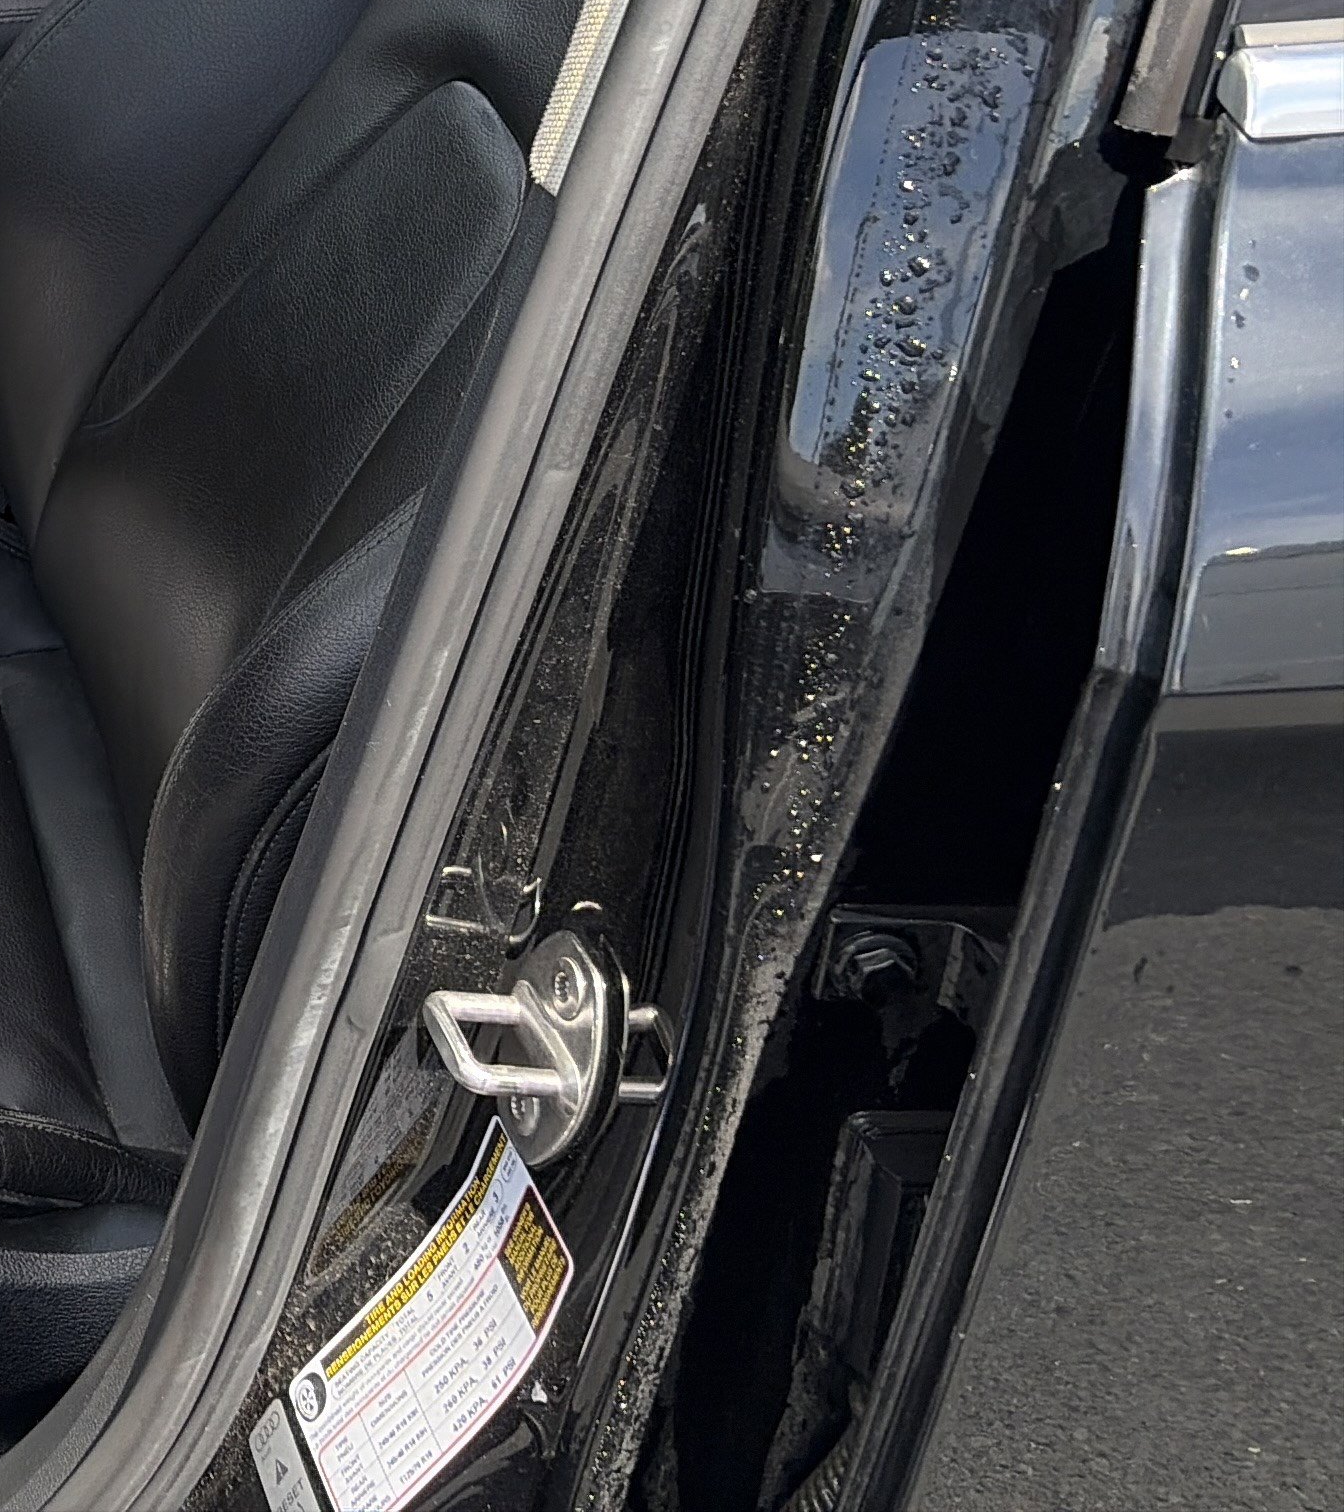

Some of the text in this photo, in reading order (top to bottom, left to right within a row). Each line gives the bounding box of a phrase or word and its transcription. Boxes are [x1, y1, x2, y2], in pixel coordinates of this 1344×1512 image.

[366, 1177, 480, 1324] TIRE AND LOADING INFORMATION
[401, 1278, 420, 1303] SUR
[418, 1260, 434, 1283] LES
[433, 1230, 457, 1265] PNEUS
[473, 1133, 506, 1205] CHARGEMENT
[484, 1317, 497, 1338] PSI
[503, 1355, 516, 1376] PSI
[443, 1392, 459, 1414] 260
[493, 1335, 506, 1357] PSI
